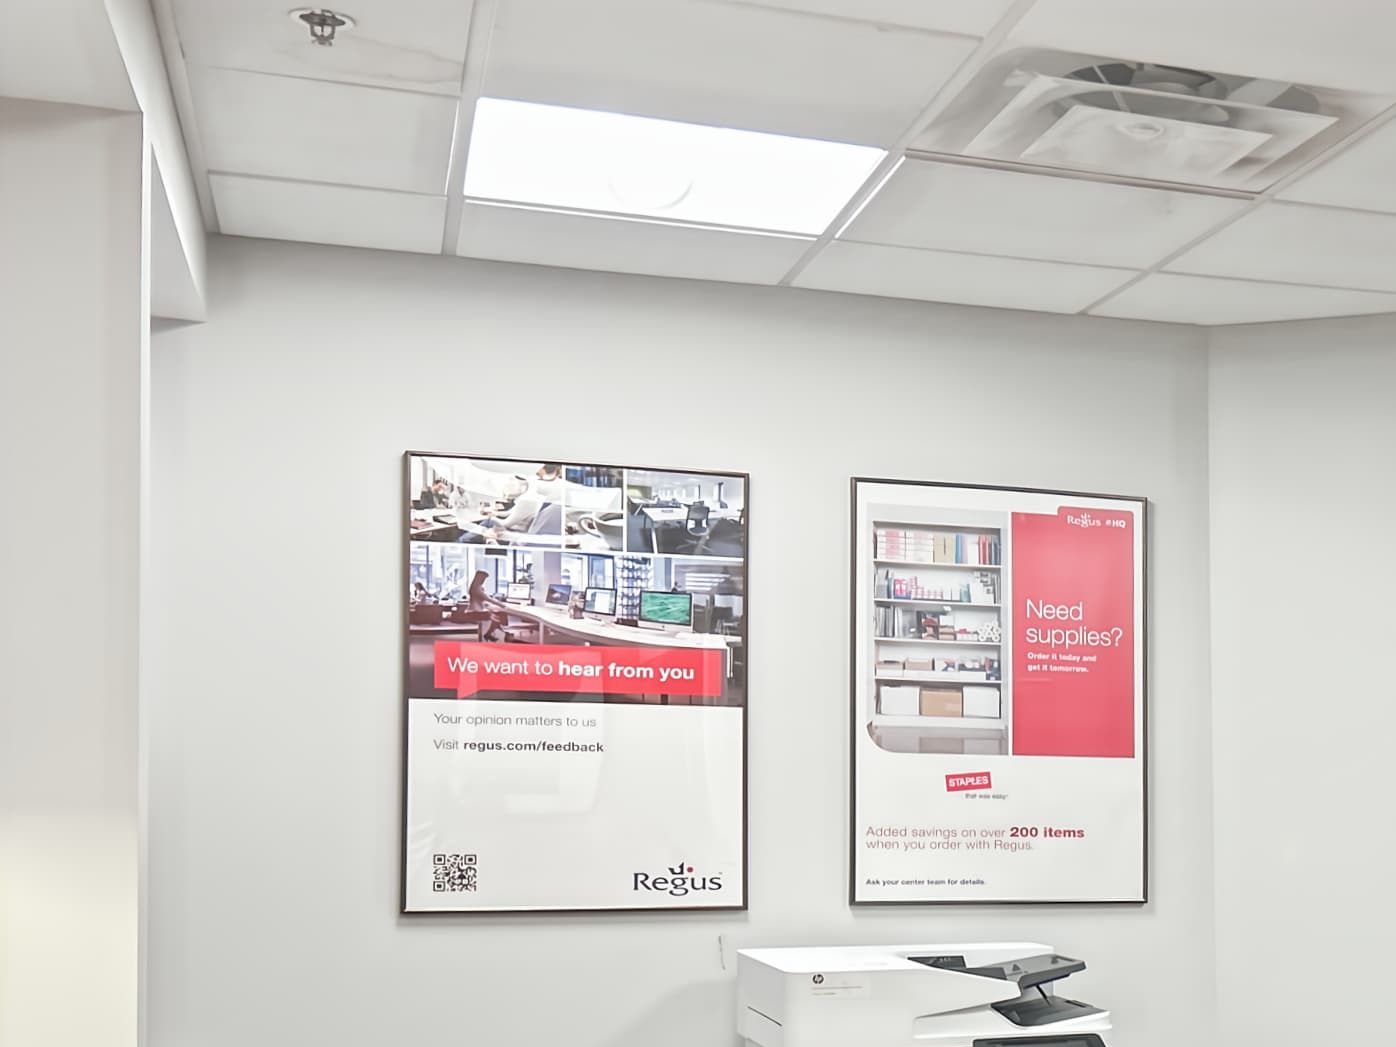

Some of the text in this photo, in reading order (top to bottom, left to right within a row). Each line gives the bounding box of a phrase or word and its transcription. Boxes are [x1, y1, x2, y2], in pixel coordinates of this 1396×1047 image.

[1067, 513, 1101, 528] Regus
[1026, 598, 1083, 621] Need
[1025, 625, 1123, 649] supplies?
[1027, 651, 1050, 660] Order
[1058, 653, 1081, 663] today
[1082, 654, 1097, 662] and
[447, 657, 695, 682] We want to hear from you
[1027, 663, 1040, 672] get
[433, 713, 597, 728] Your opinion matters to us
[433, 738, 604, 753] Visit regus.com/feedback
[948, 775, 990, 788] STAPLES
[866, 826, 1085, 840] Added savings on over 200 items
[866, 839, 900, 850] when
[903, 841, 926, 853] you
[929, 839, 961, 850] order
[965, 839, 990, 850] with
[632, 869, 723, 897] Regus
[882, 879, 900, 887] your
